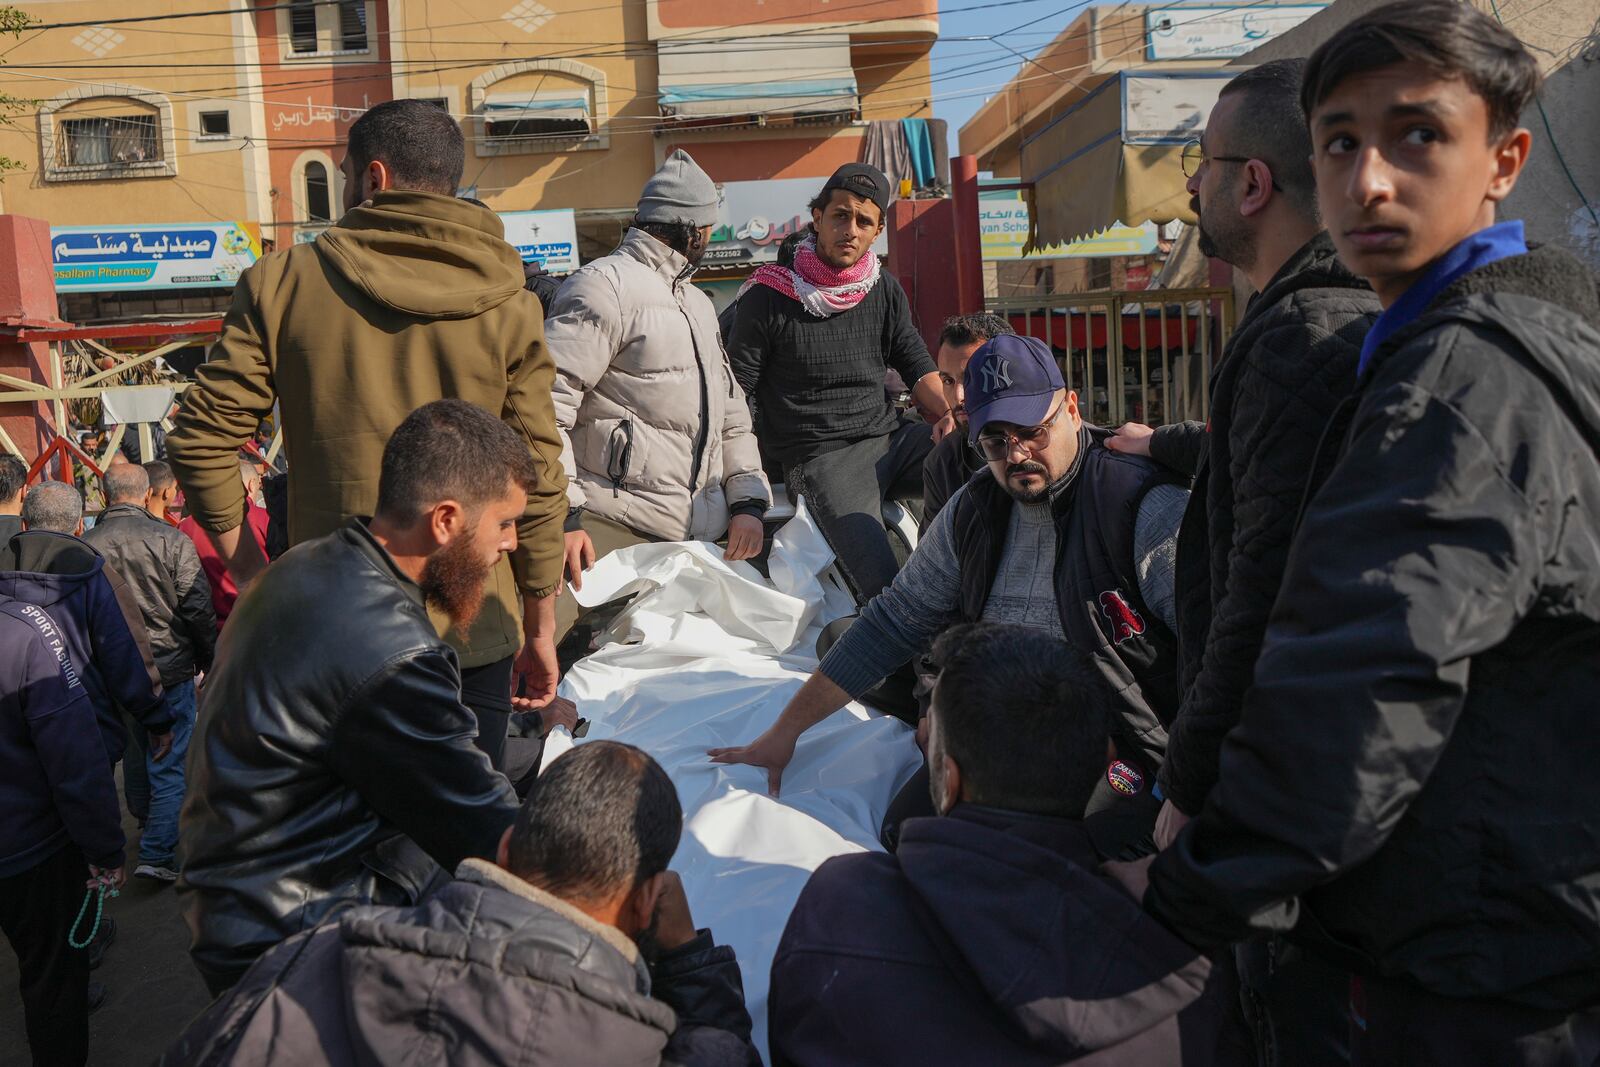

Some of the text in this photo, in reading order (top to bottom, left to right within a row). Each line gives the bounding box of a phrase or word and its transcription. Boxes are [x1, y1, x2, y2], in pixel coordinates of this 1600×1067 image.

[130, 232, 211, 259] صيدلية
[535, 244, 569, 257] صيدلية
[98, 266, 152, 280] Pharmacy
[21, 605, 81, 689] SPORT FASHION
